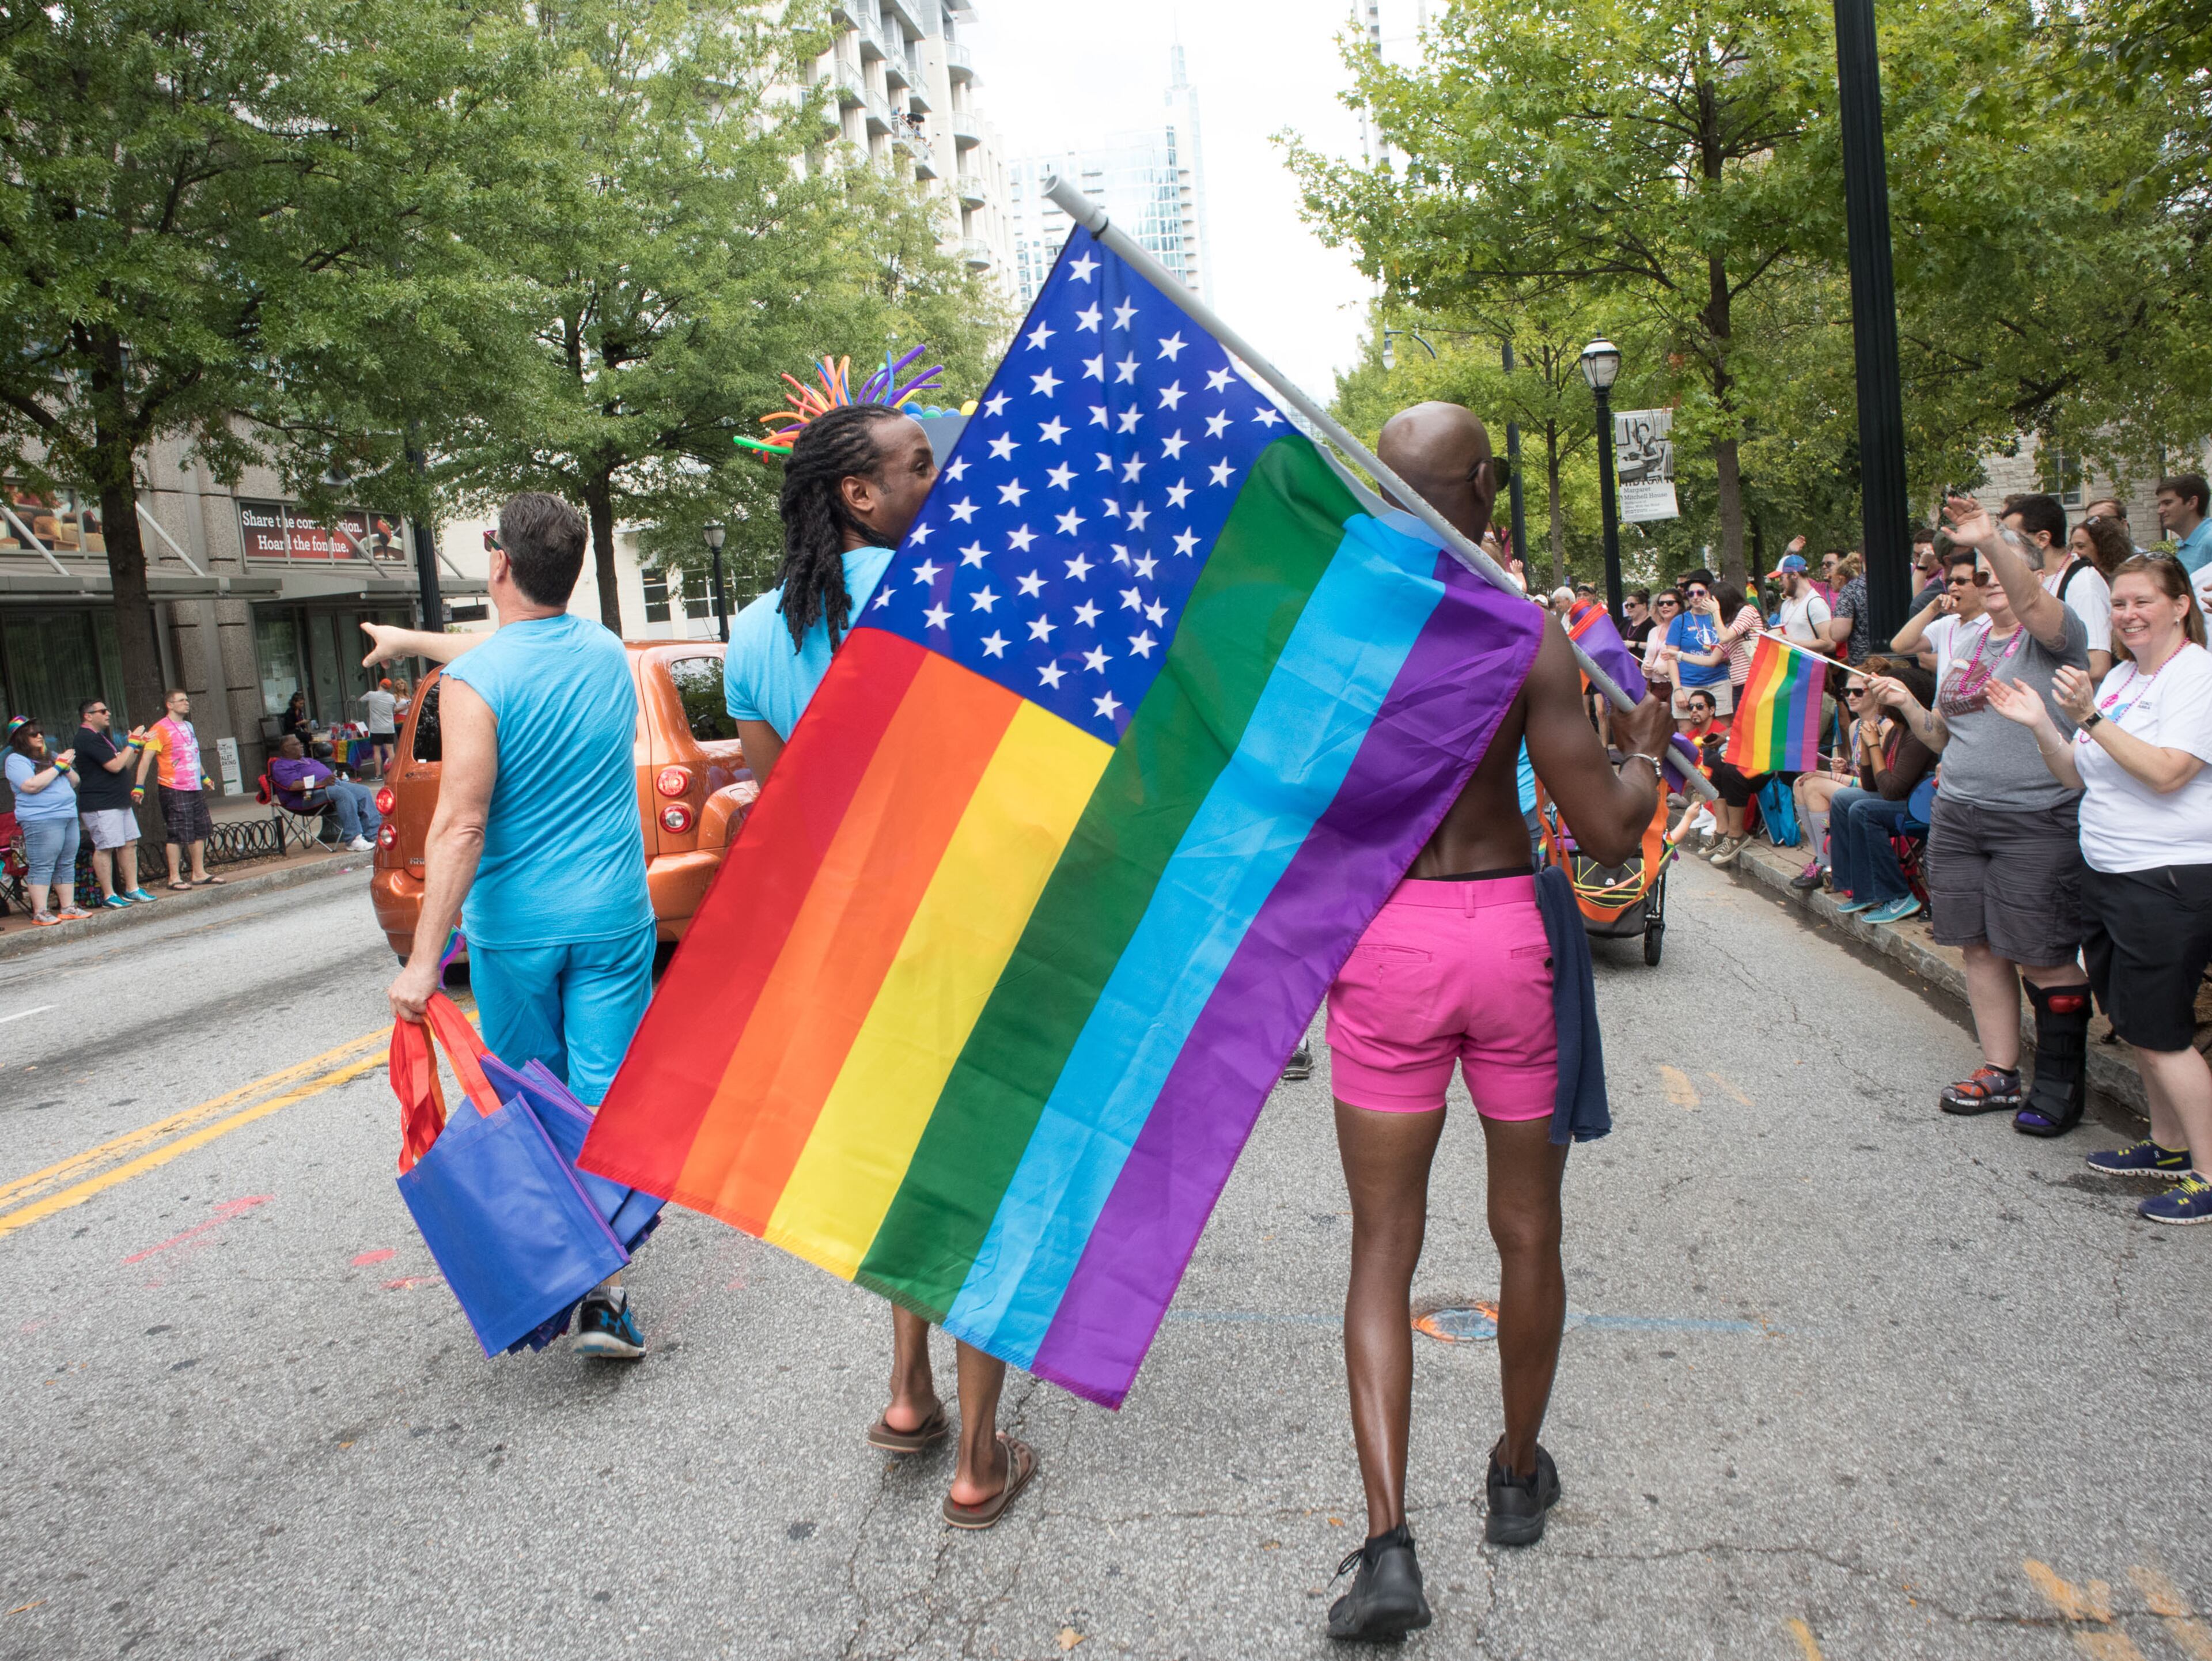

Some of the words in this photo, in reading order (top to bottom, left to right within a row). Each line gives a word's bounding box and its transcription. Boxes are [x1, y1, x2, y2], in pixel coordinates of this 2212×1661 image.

[243, 509, 275, 527] Share
[293, 534, 310, 551] the
[1946, 699, 1976, 715] STATE
